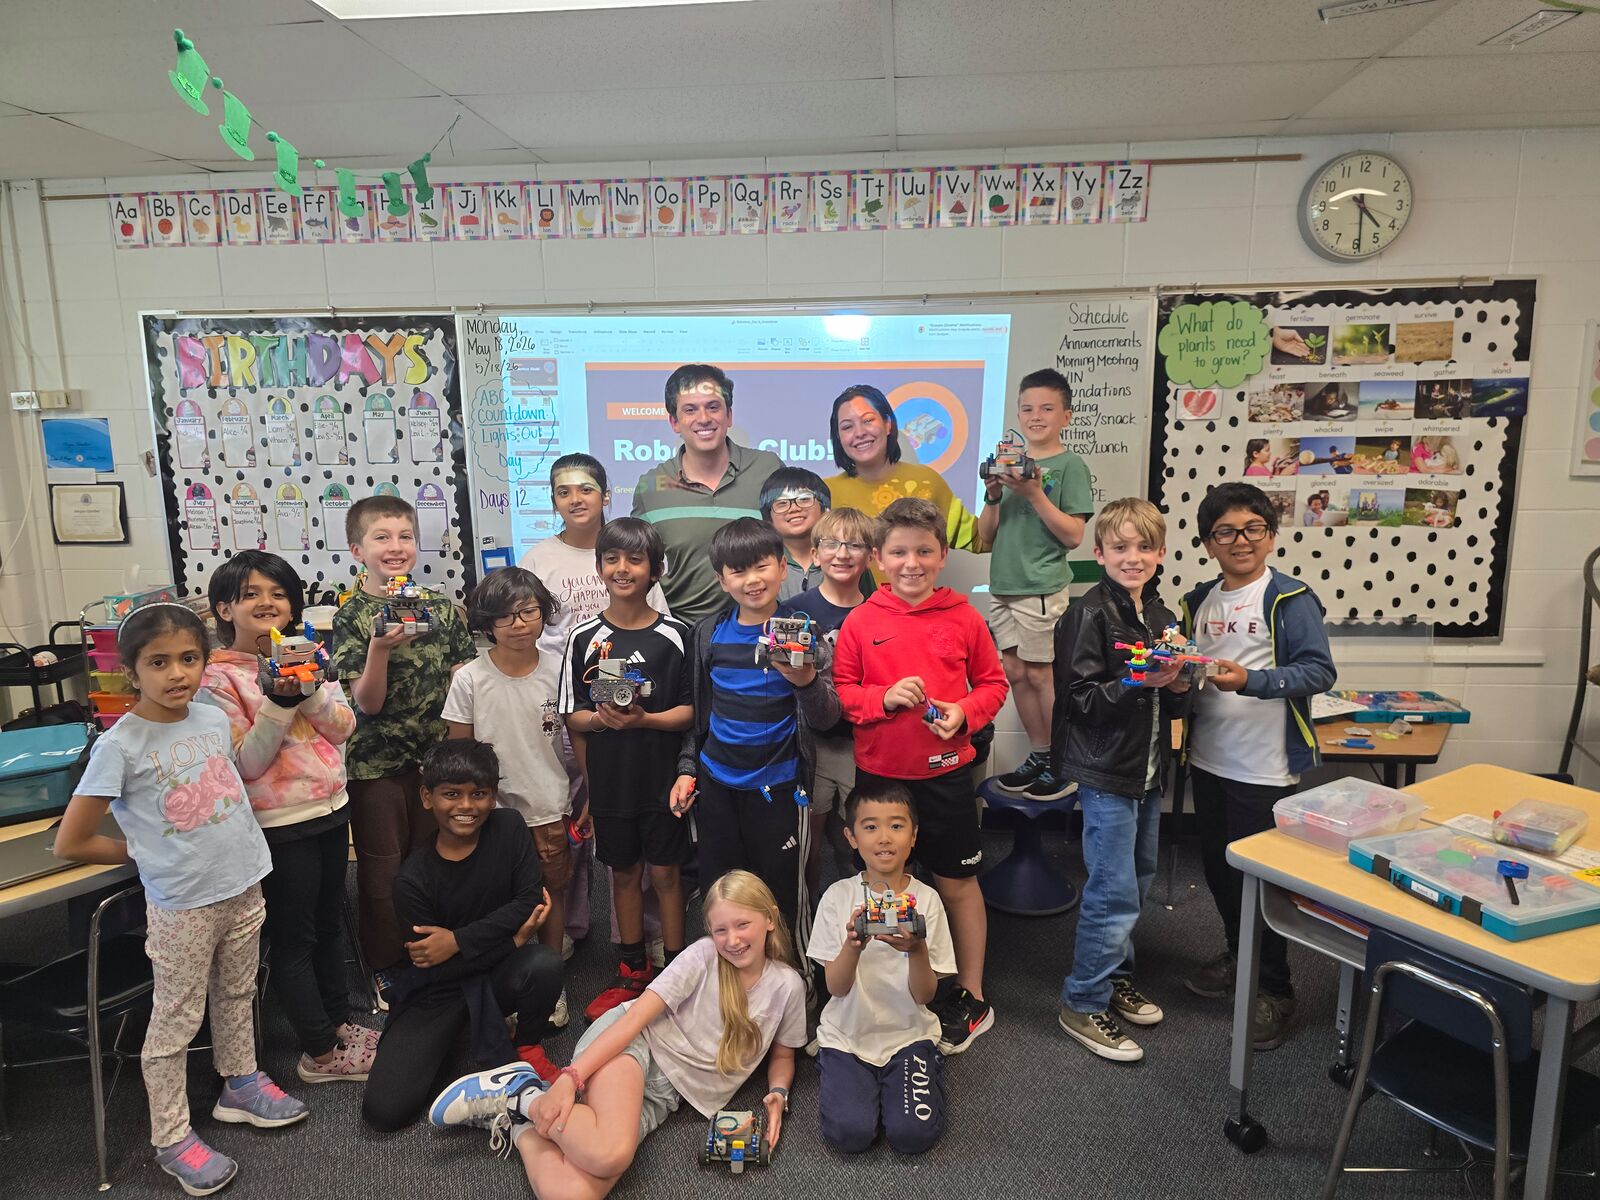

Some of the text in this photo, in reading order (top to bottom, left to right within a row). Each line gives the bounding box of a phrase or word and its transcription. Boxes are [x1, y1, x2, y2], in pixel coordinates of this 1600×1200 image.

[1342, 166, 1351, 178] 11
[1360, 160, 1372, 173] 12
[1382, 166, 1387, 178] 1
[861, 178, 884, 197] Tt
[902, 176, 926, 196] Uu
[946, 174, 970, 194] Vv
[984, 174, 1015, 191] Ww
[1032, 172, 1055, 192] Xx
[1072, 170, 1096, 195] Yy
[1118, 168, 1143, 189] Zz
[1325, 180, 1336, 192] 10
[1393, 180, 1401, 192] 2
[494, 189, 517, 208] Kk
[537, 188, 554, 207] Ll
[570, 188, 600, 206] Mm
[615, 186, 639, 206] Nn
[654, 185, 679, 204] Oo
[699, 184, 720, 208] Pp
[734, 182, 762, 206] Qq
[780, 180, 802, 200] Rr
[820, 179, 842, 199] Ss
[115, 201, 138, 219] Aa
[153, 198, 175, 217] Bb
[189, 198, 211, 216] Cc
[229, 196, 251, 215] Dd
[266, 195, 288, 214] Ee
[304, 194, 326, 213] Ff
[458, 190, 476, 214] Jj
[1318, 201, 1326, 212] 9
[1396, 200, 1404, 211] 3
[1322, 219, 1330, 231] 8
[1388, 220, 1396, 231] 4
[1335, 232, 1342, 244] 7
[1352, 238, 1360, 250] 6
[1372, 232, 1380, 244] 5
[1069, 302, 1129, 324] Schedule
[1177, 308, 1243, 335] What do
[1346, 314, 1381, 322] germinate
[466, 318, 523, 339] Monday,
[467, 338, 492, 362] May
[508, 336, 536, 352] 2026
[1059, 330, 1142, 351] Announcements
[1178, 331, 1256, 360] plants need
[174, 333, 431, 389] BIRTHDAYS
[475, 360, 519, 376] 5/18/26
[1056, 353, 1139, 372] Morning Meeting
[1194, 350, 1250, 375] to grow?
[1268, 372, 1286, 380] feast
[1318, 370, 1347, 379] beneath
[1374, 370, 1404, 378] seaweed
[1434, 368, 1456, 378] gather
[1492, 367, 1512, 375] island
[480, 389, 510, 406] ABC
[1071, 382, 1132, 398] undations
[222, 416, 248, 424] February
[478, 404, 546, 424] Countdown
[482, 426, 541, 448] Lights Out
[1262, 428, 1284, 436] plenty
[1374, 426, 1394, 434] swipe
[1422, 425, 1460, 434] whimpered
[614, 439, 676, 462] Rob
[499, 452, 522, 476] Day
[614, 486, 635, 494] Gree
[1310, 480, 1337, 488] glanced
[1362, 479, 1394, 487] oversized
[1418, 478, 1449, 487] adorable
[480, 489, 530, 514] Days 12
[146, 732, 228, 784] LOVE
[912, 1055, 932, 1121] POLO
